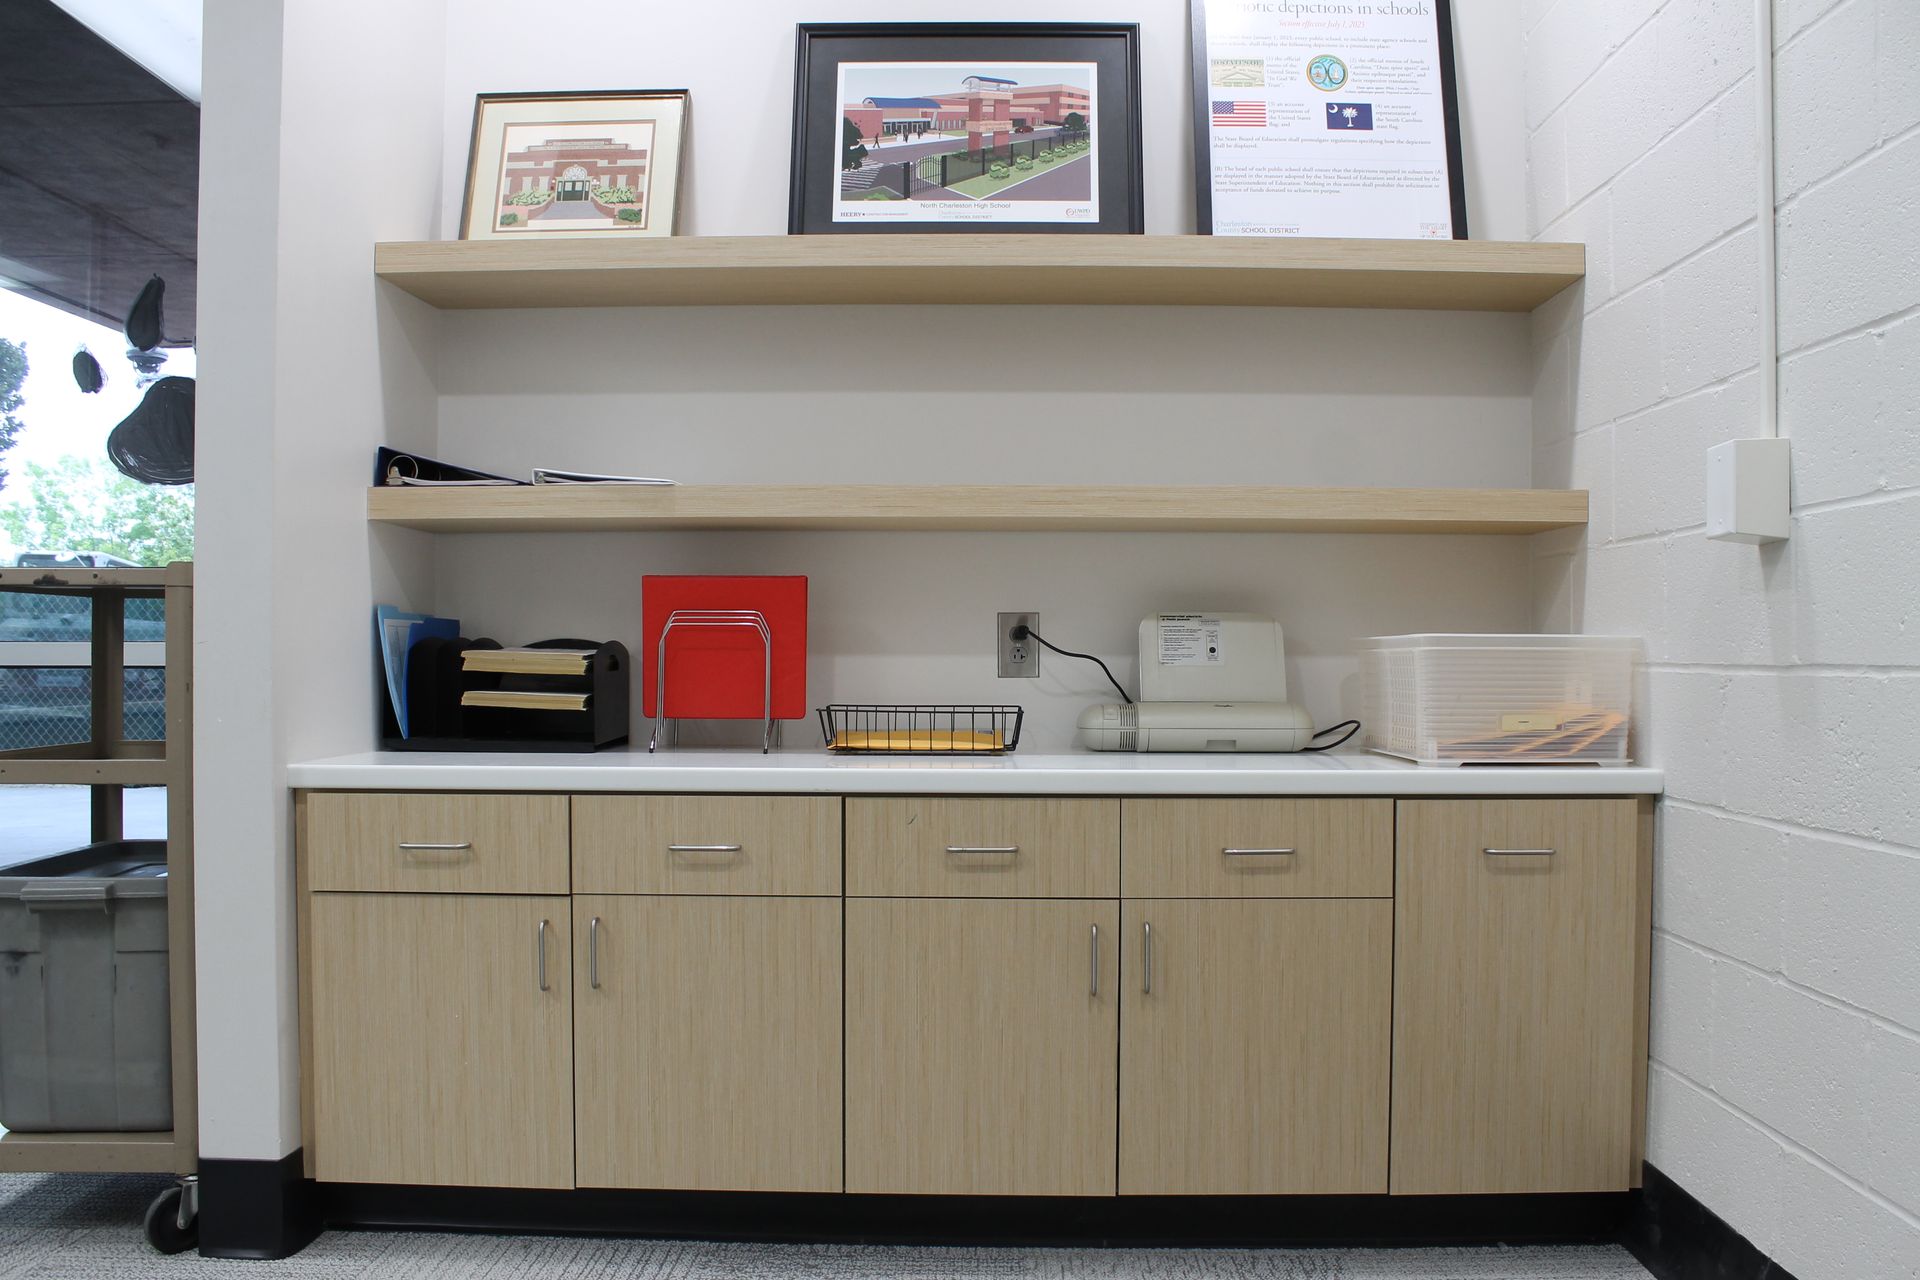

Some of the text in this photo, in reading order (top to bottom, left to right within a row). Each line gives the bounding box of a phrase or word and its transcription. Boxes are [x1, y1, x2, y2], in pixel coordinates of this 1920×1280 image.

[1278, 0, 1353, 18] depictions
[1358, 4, 1372, 15] in
[1377, 1, 1429, 15] schools
[1327, 19, 1340, 30] July
[1223, 173, 1247, 181] displayed
[1228, 180, 1267, 188] Superintendent
[1303, 181, 1325, 189] Nothing
[973, 202, 989, 210] High
[1268, 227, 1300, 235] DISTRICT
